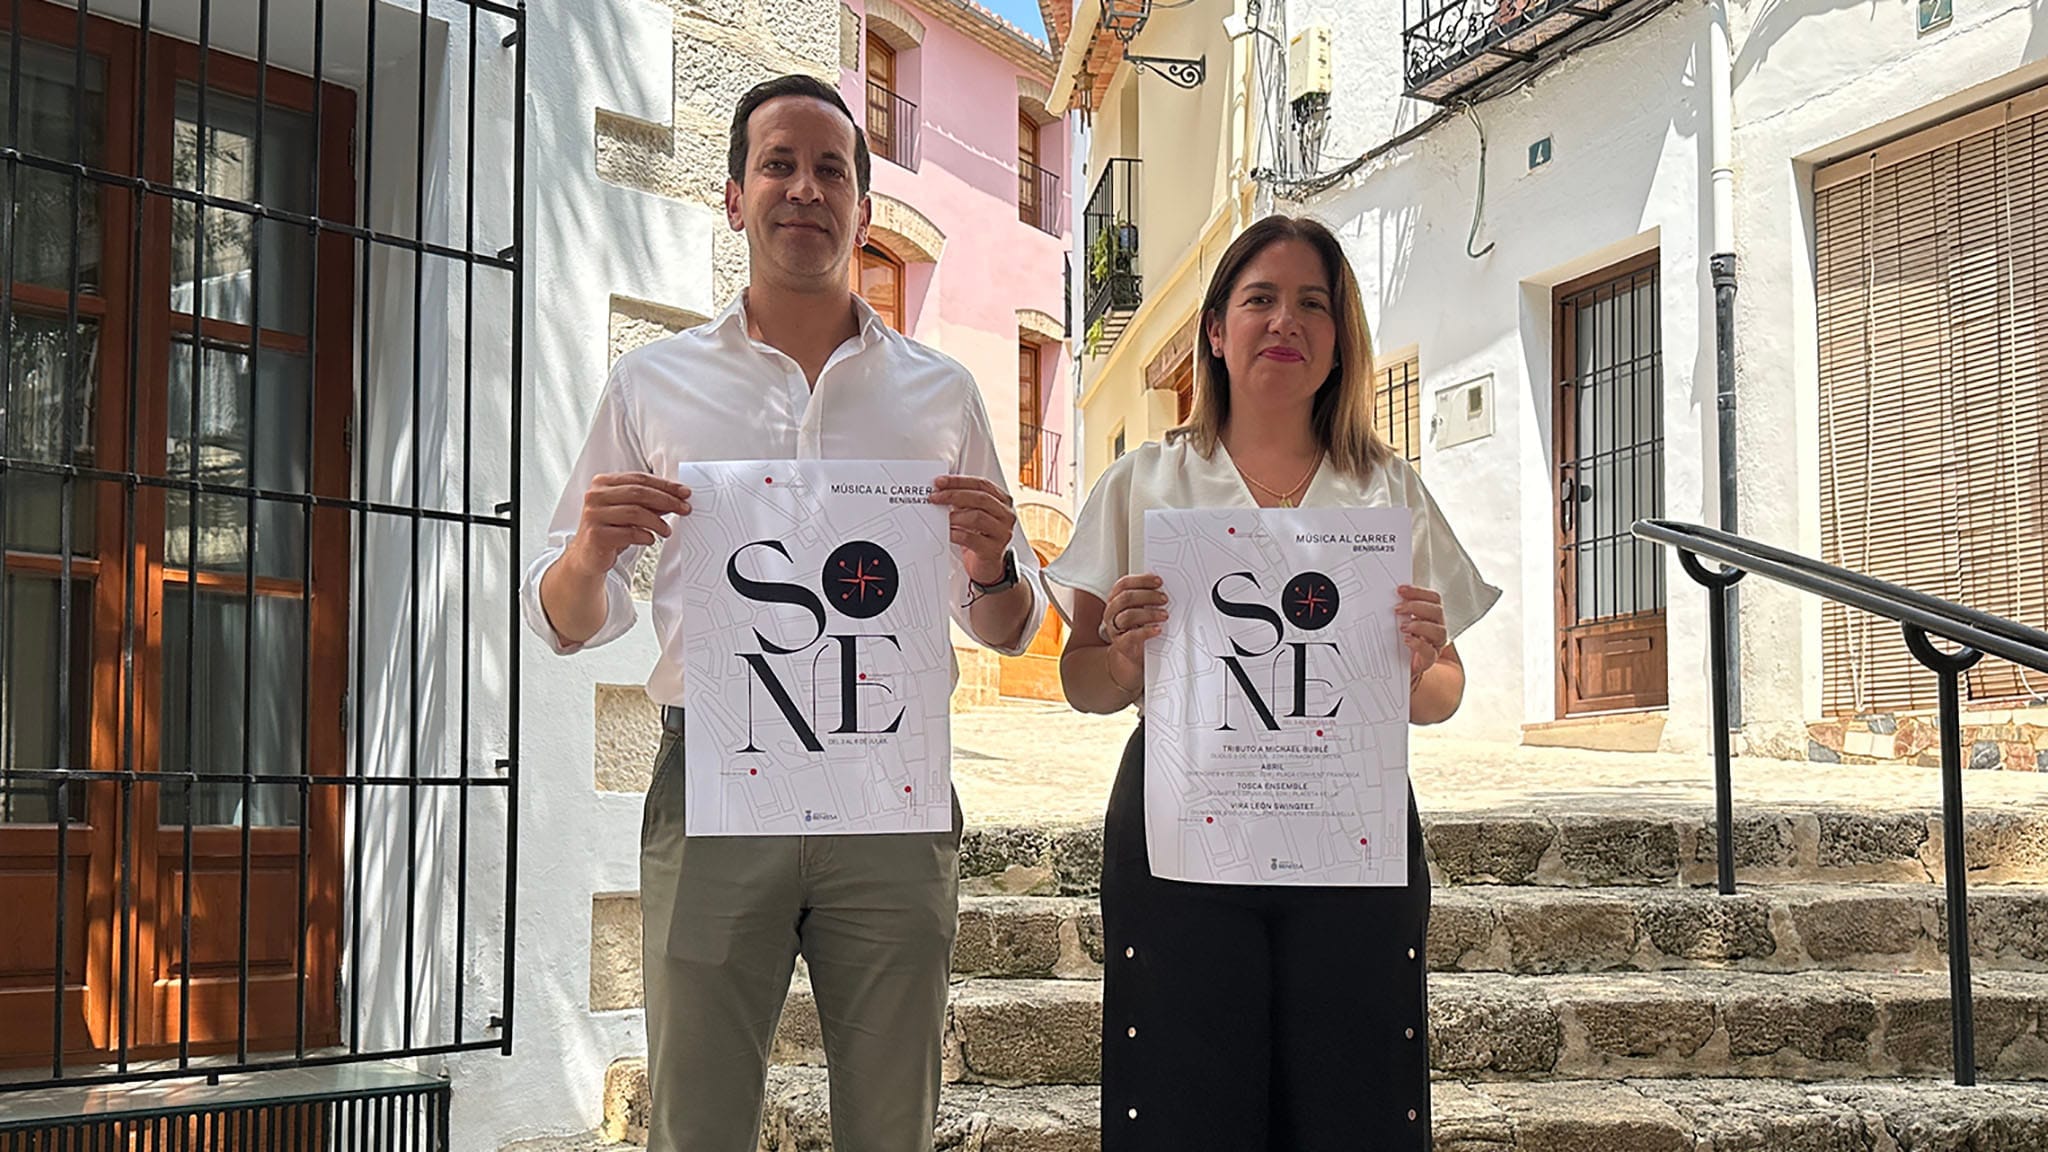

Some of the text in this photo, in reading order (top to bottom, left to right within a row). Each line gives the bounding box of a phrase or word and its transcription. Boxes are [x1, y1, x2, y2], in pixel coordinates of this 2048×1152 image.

[1928, 0, 1942, 24] 2
[1535, 143, 1545, 164] 4
[830, 483, 933, 496] MÚSICA AL CARRER
[1295, 533, 1397, 544] MÚSICA AL CARRER
[1223, 745, 1257, 753] TRIBUTO
[1265, 745, 1301, 753] MICHAEL
[1237, 782, 1308, 790] TOSCA ENSEMBLE
